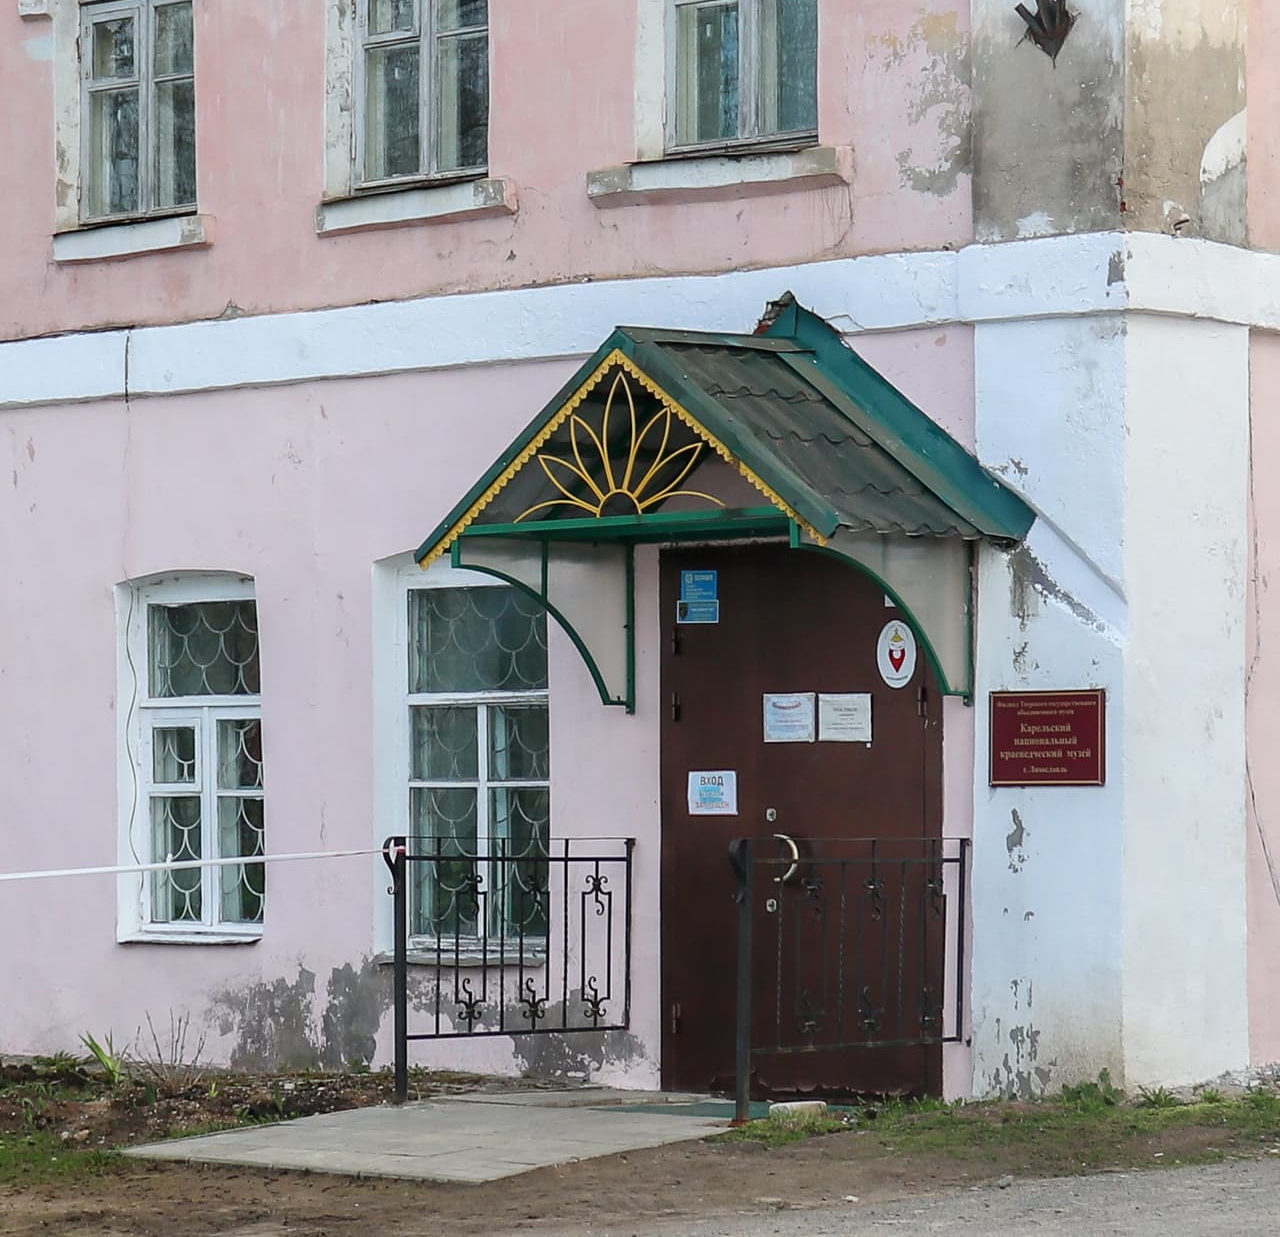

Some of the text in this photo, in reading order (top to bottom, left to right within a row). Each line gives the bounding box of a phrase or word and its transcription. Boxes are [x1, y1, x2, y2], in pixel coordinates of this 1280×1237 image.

[1020, 723, 1071, 735] Карельский
[1014, 736, 1077, 745] национальный
[1000, 748, 1091, 761] краеведческий музей
[700, 776, 724, 786] ВХОД
